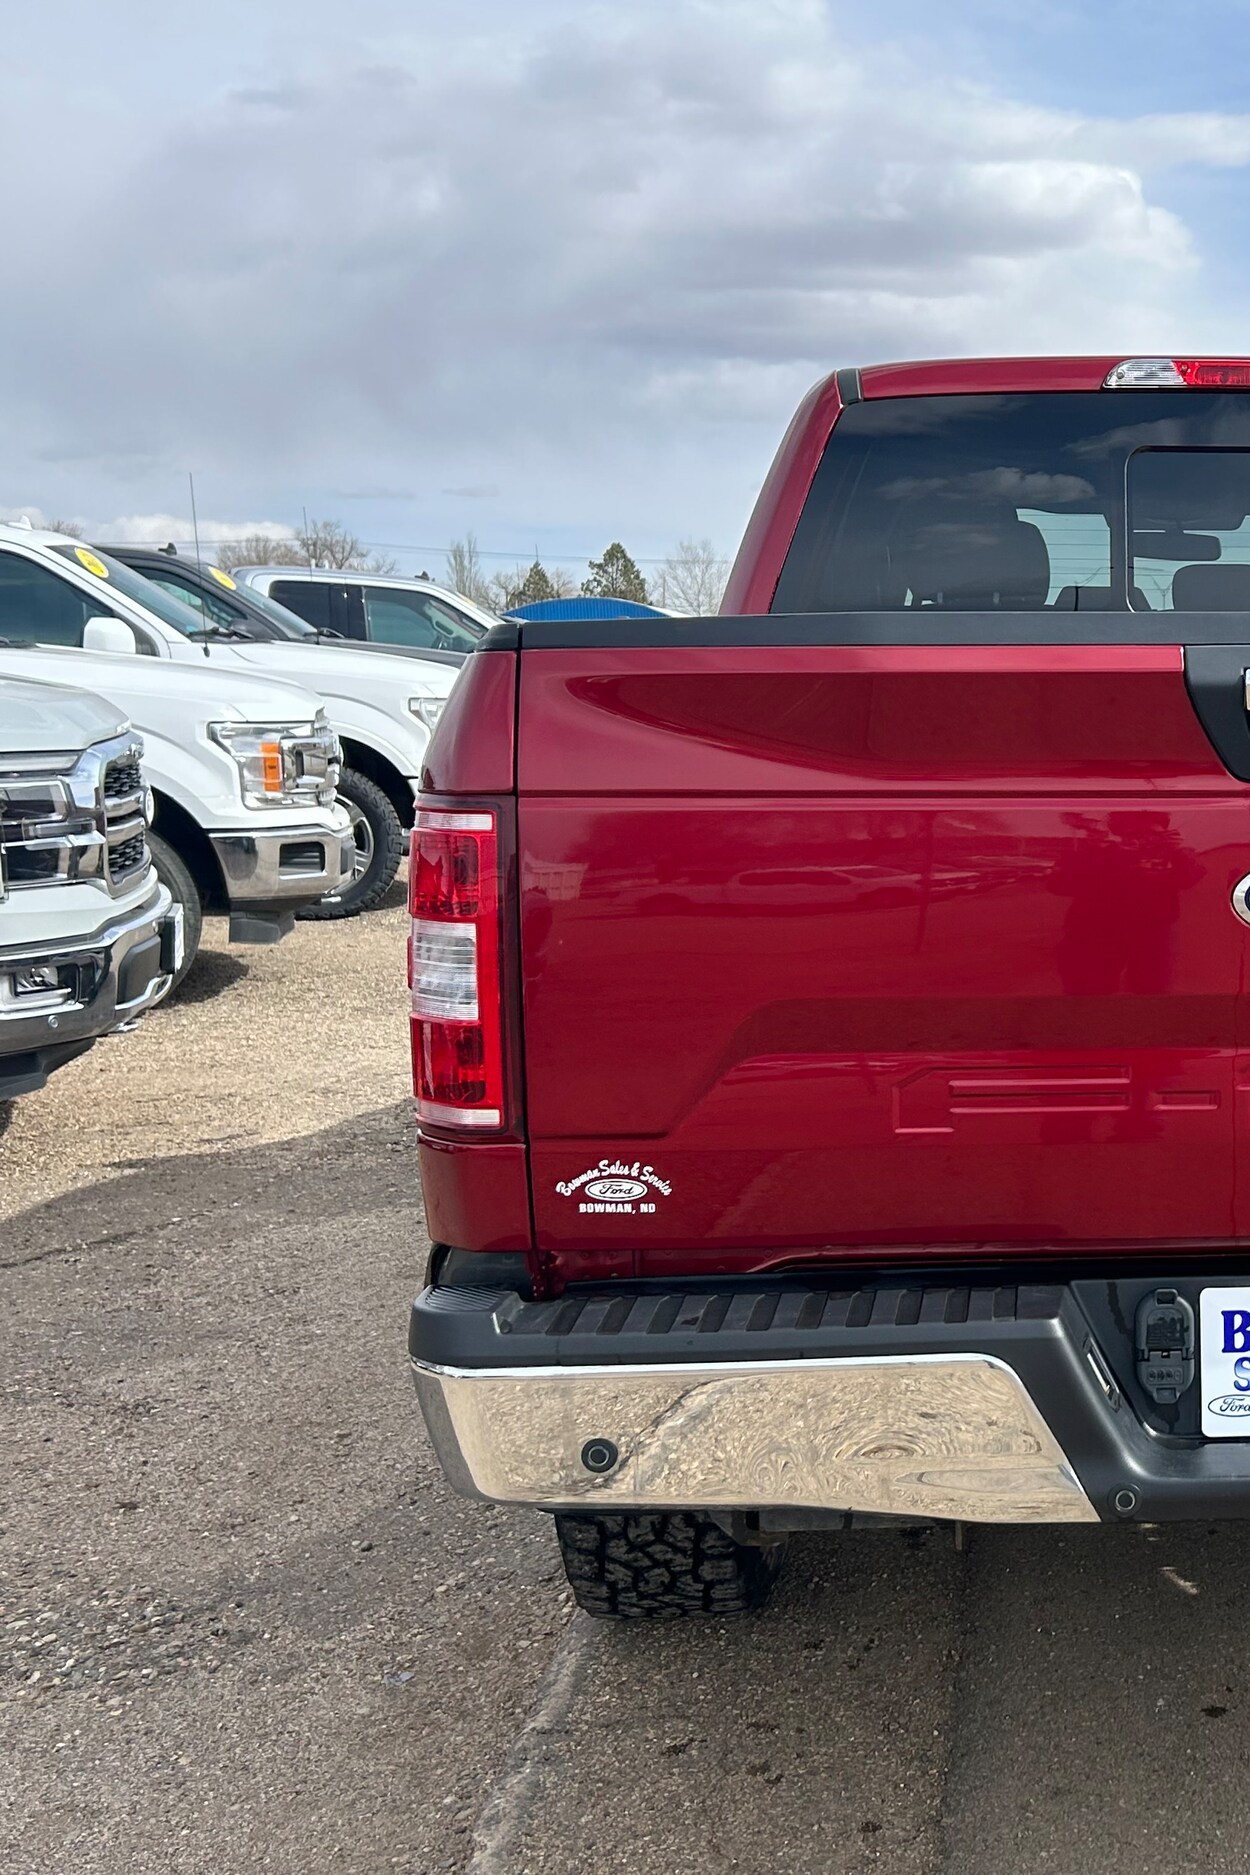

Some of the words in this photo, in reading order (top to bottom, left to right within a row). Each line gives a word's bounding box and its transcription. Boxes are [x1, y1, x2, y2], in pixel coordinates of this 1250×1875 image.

[555, 1168, 600, 1196] Bowman
[599, 1160, 630, 1177] Sales
[630, 1162, 640, 1177] &
[640, 1166, 673, 1196] Service
[599, 1183, 635, 1195] Ford
[578, 1203, 637, 1215] BOWMAN,
[640, 1203, 656, 1213] ND
